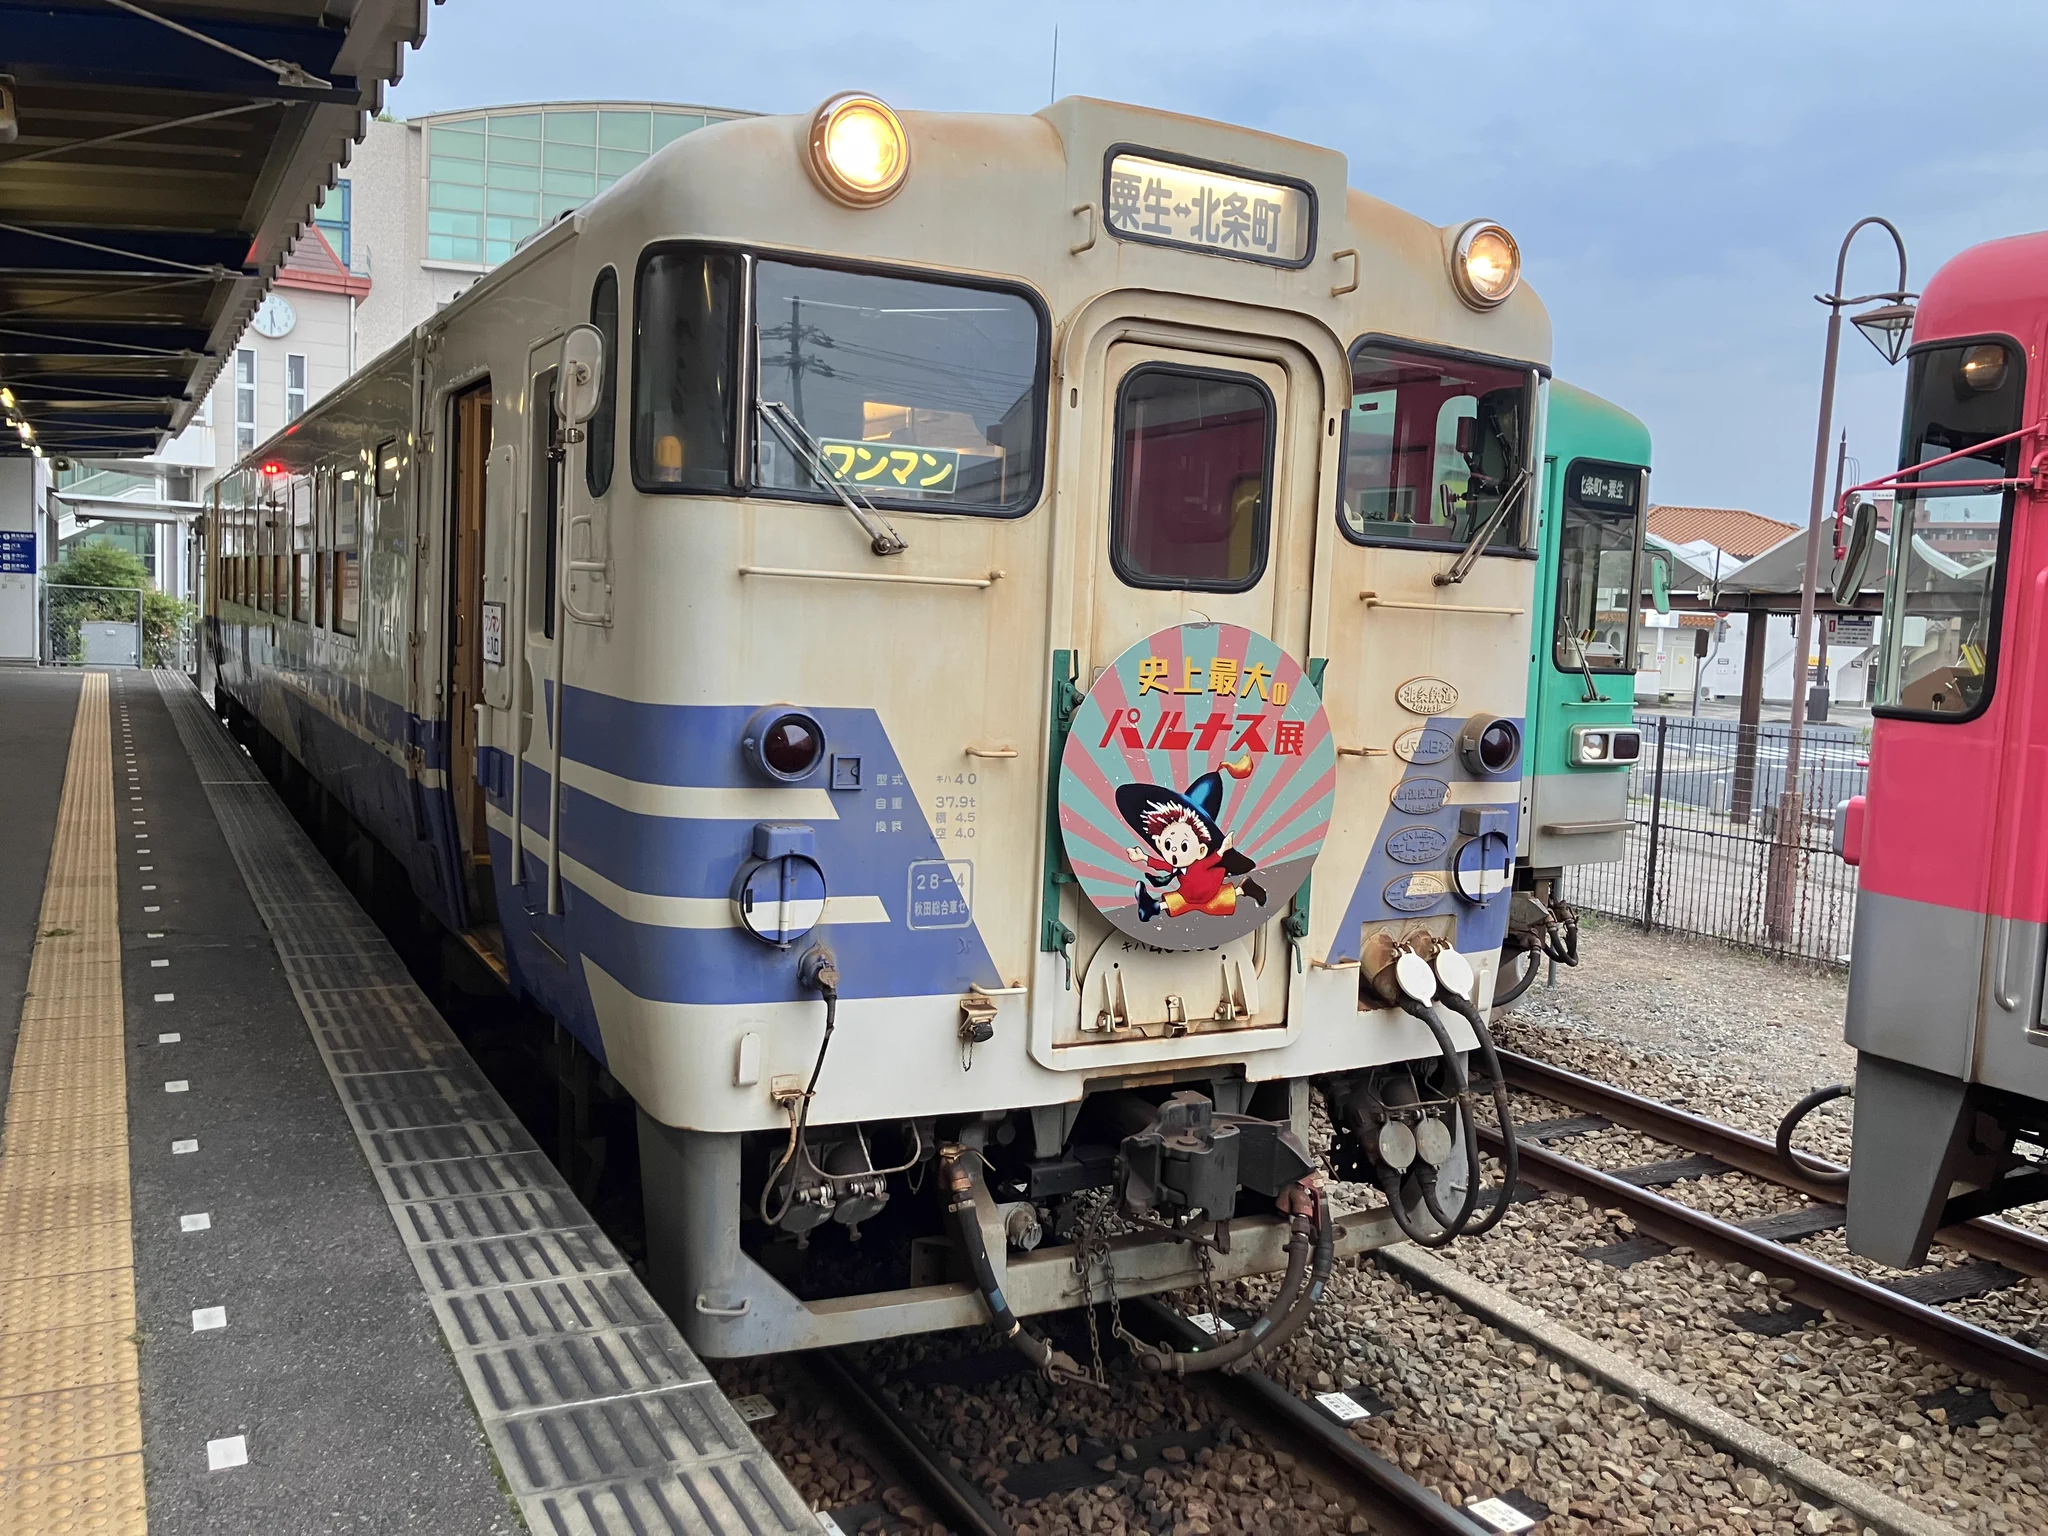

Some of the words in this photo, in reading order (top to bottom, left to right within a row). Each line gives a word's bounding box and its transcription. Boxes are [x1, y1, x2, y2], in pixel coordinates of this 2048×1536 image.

[1110, 171, 1172, 235] 粟生
[1190, 186, 1281, 253] 北条町
[823, 445, 952, 487] ワンマン
[1138, 656, 1288, 707] 史上最大の
[1099, 707, 1305, 756] パルナス展
[876, 774, 904, 786] 型式
[875, 797, 903, 810] 自重
[935, 796, 976, 809] 37.9t
[955, 812, 976, 823] 4.5
[935, 827, 947, 840] 空
[954, 827, 976, 838] 4.0
